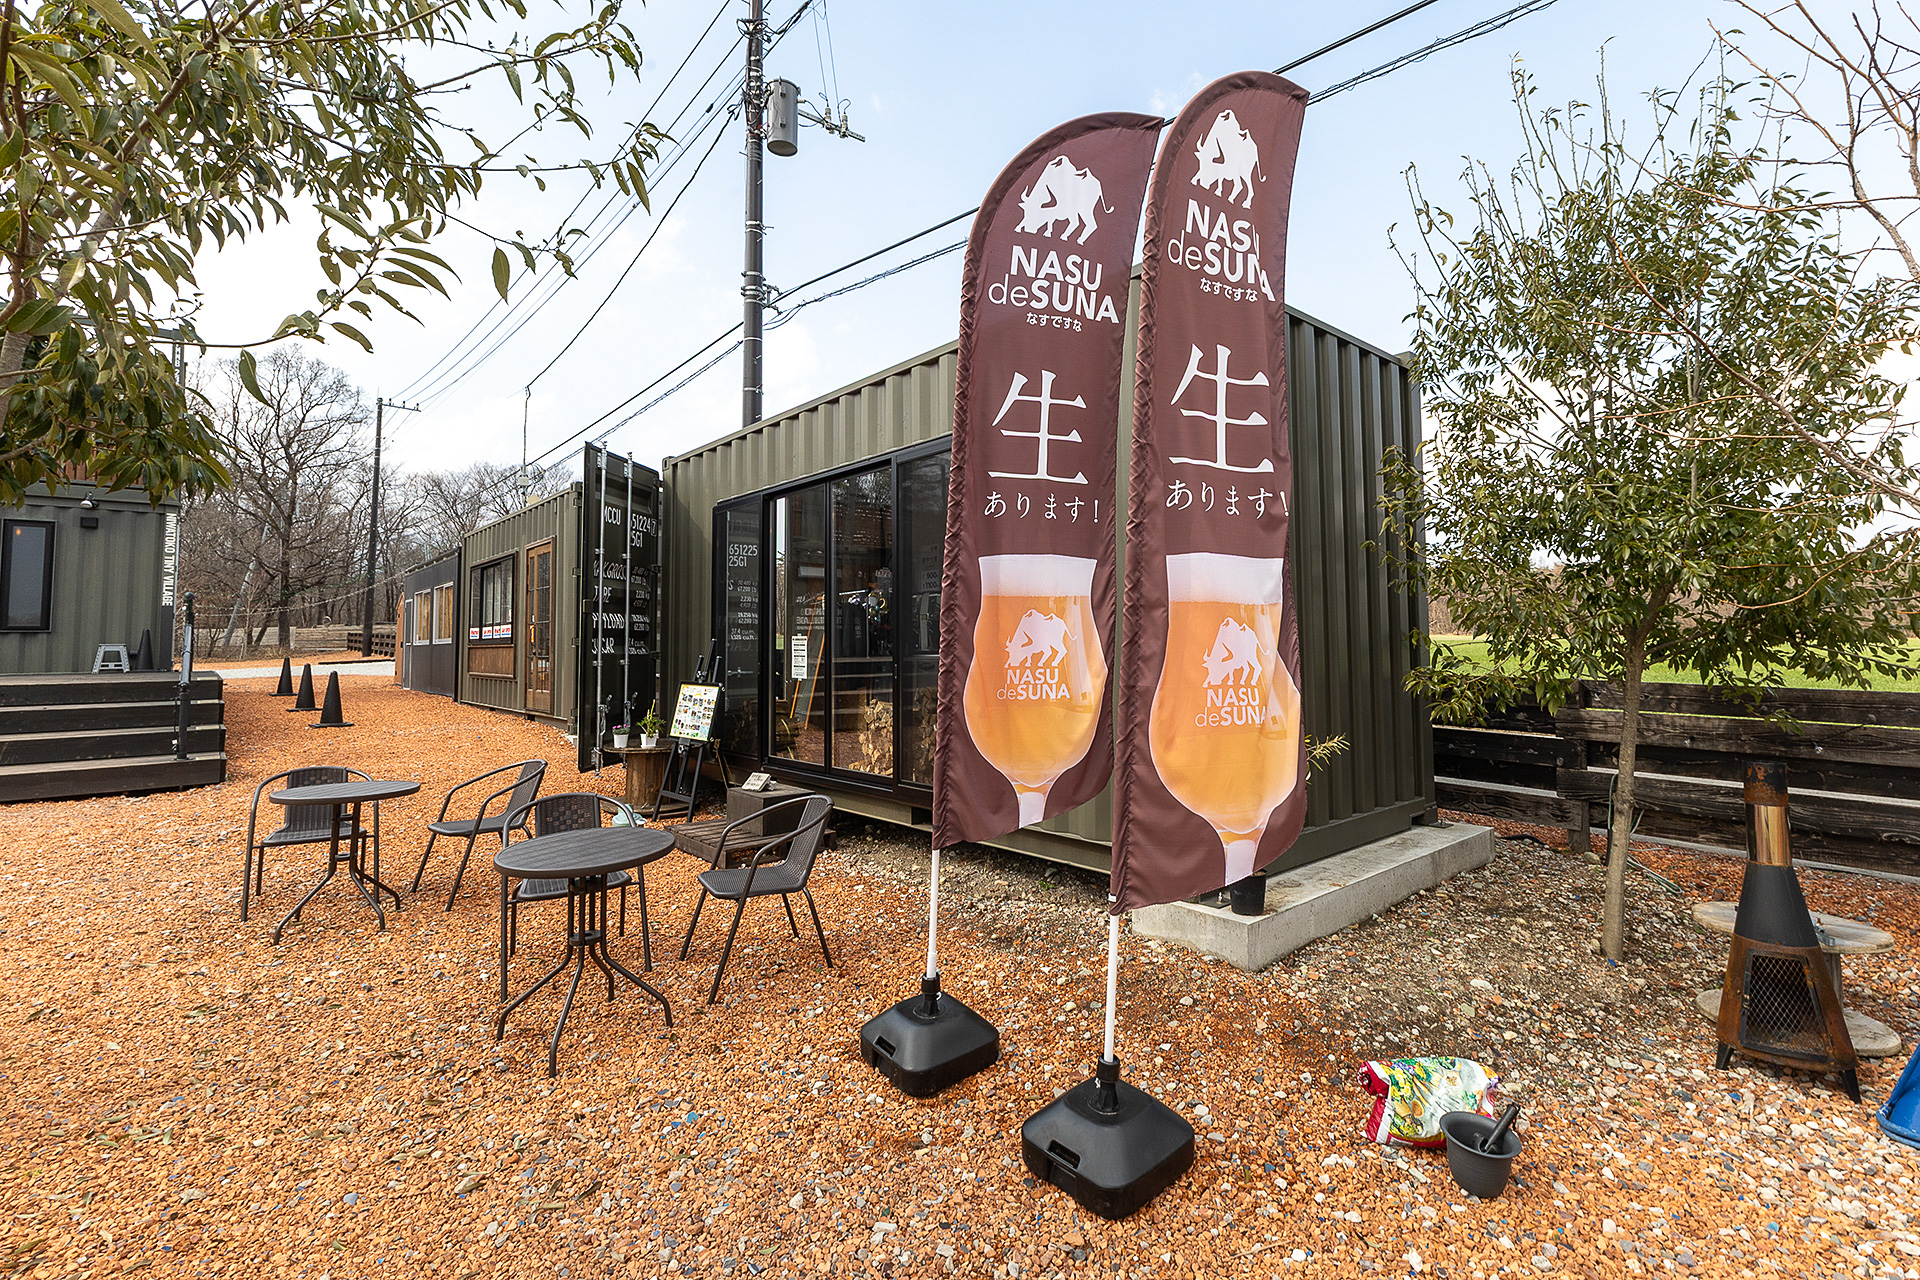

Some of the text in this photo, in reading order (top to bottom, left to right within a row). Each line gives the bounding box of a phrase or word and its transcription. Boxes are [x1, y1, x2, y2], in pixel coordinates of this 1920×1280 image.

[1185, 198, 1260, 261] NASU
[1010, 245, 1103, 290] NASU
[1167, 229, 1276, 302] deSUNA
[988, 274, 1120, 324] deSUNA
[1199, 277, 1259, 302] なすですな
[1026, 311, 1083, 333] なすですな
[1168, 343, 1275, 474] 生
[988, 369, 1089, 486] 生
[984, 490, 1099, 524] あります!
[1165, 479, 1290, 519] あります!
[630, 513, 650, 533] 51224
[162, 512, 177, 607] NIWATOKO TINY VILLAGE
[728, 544, 758, 556] 651225
[728, 556, 747, 567] 25G1
[593, 585, 612, 603] TRE
[592, 612, 625, 629] PYLOAD
[1007, 668, 1059, 684] NASU
[996, 683, 1071, 700] deSUNA
[1207, 687, 1260, 707] NASU
